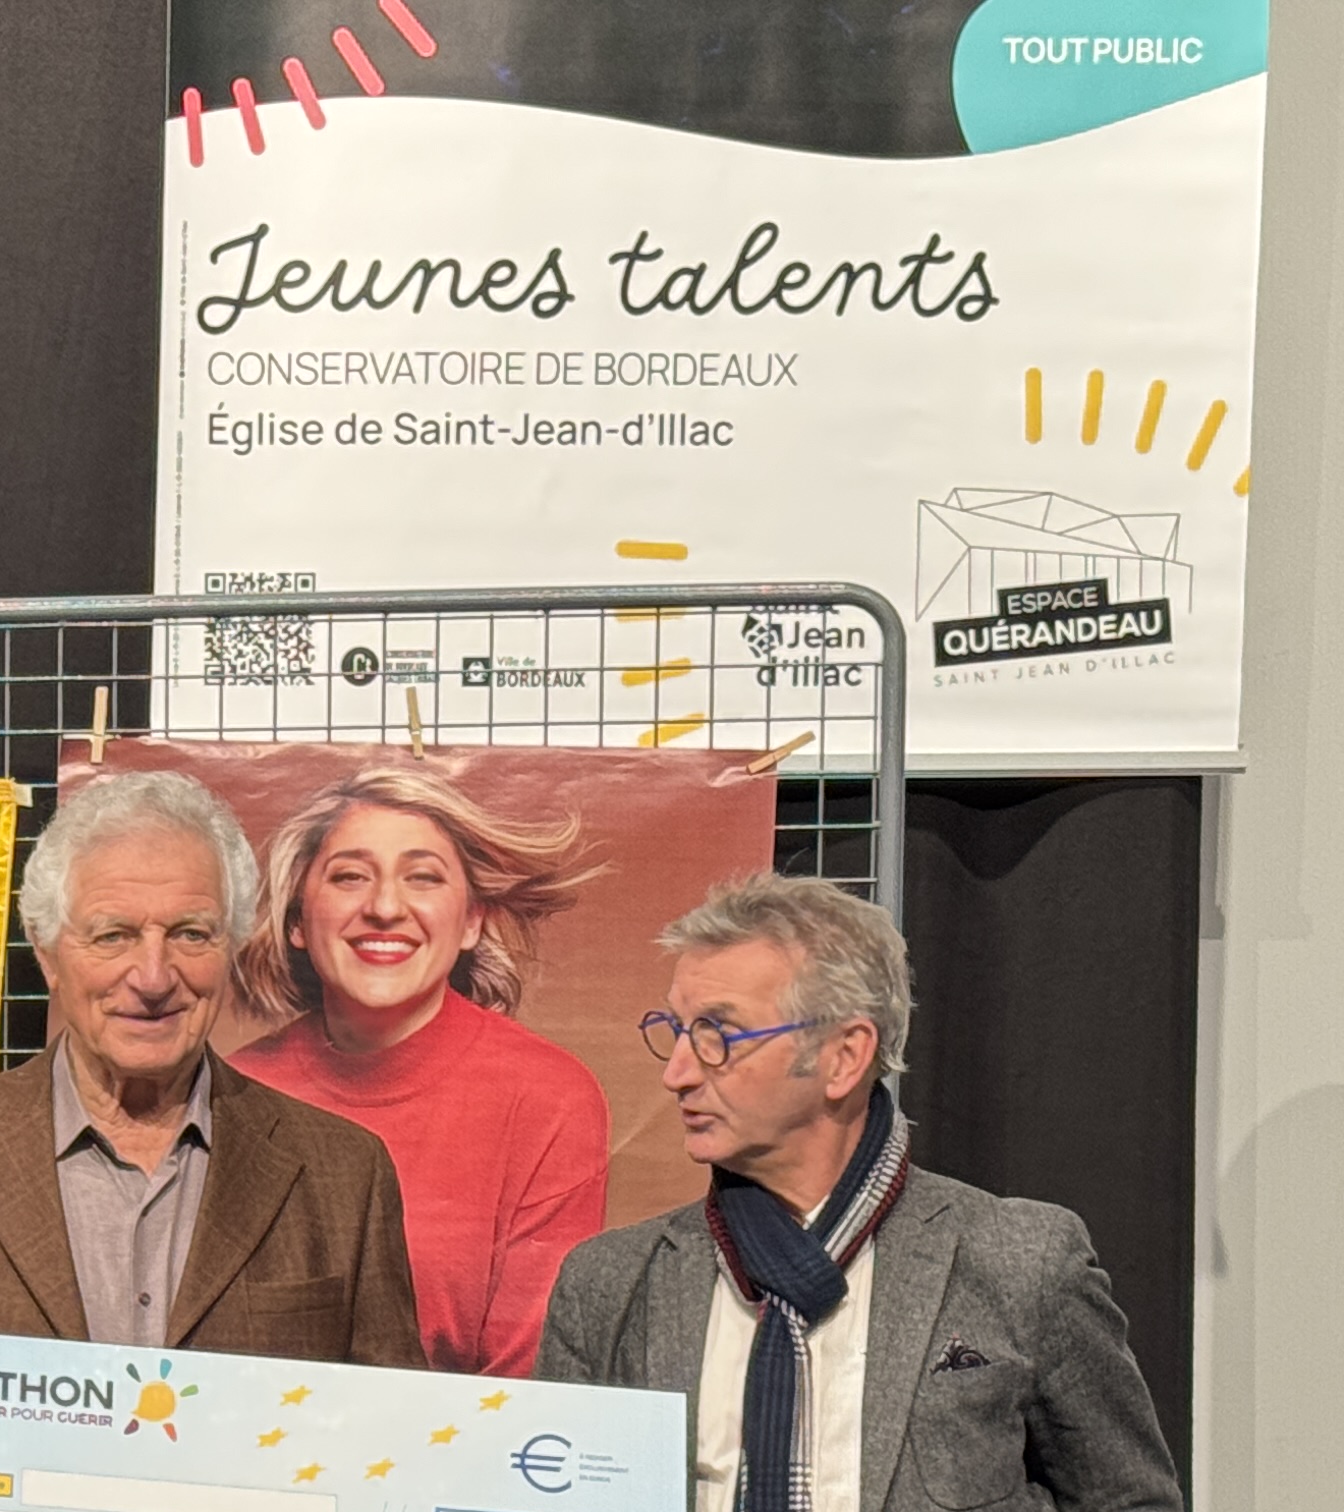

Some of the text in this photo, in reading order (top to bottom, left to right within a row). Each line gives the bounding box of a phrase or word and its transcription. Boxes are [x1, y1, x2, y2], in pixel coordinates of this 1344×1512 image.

[1003, 37, 1203, 64] TOUT PUBLIC
[196, 223, 576, 335] Jeunes
[608, 222, 1000, 321] talents
[207, 351, 798, 388] CONSERVATOIRE DE BORDEAUX
[208, 402, 323, 456] Église
[334, 412, 382, 447] de
[1007, 587, 1099, 615] ESPACE
[787, 621, 865, 649] Jean
[943, 609, 1162, 656] QUÉRANDEAU
[497, 656, 537, 667] Ville de
[933, 669, 999, 688] SAINT
[1016, 662, 1070, 680] JEAN
[496, 671, 586, 688] BORDEAUX
[11, 1407, 53, 1423] POUR
